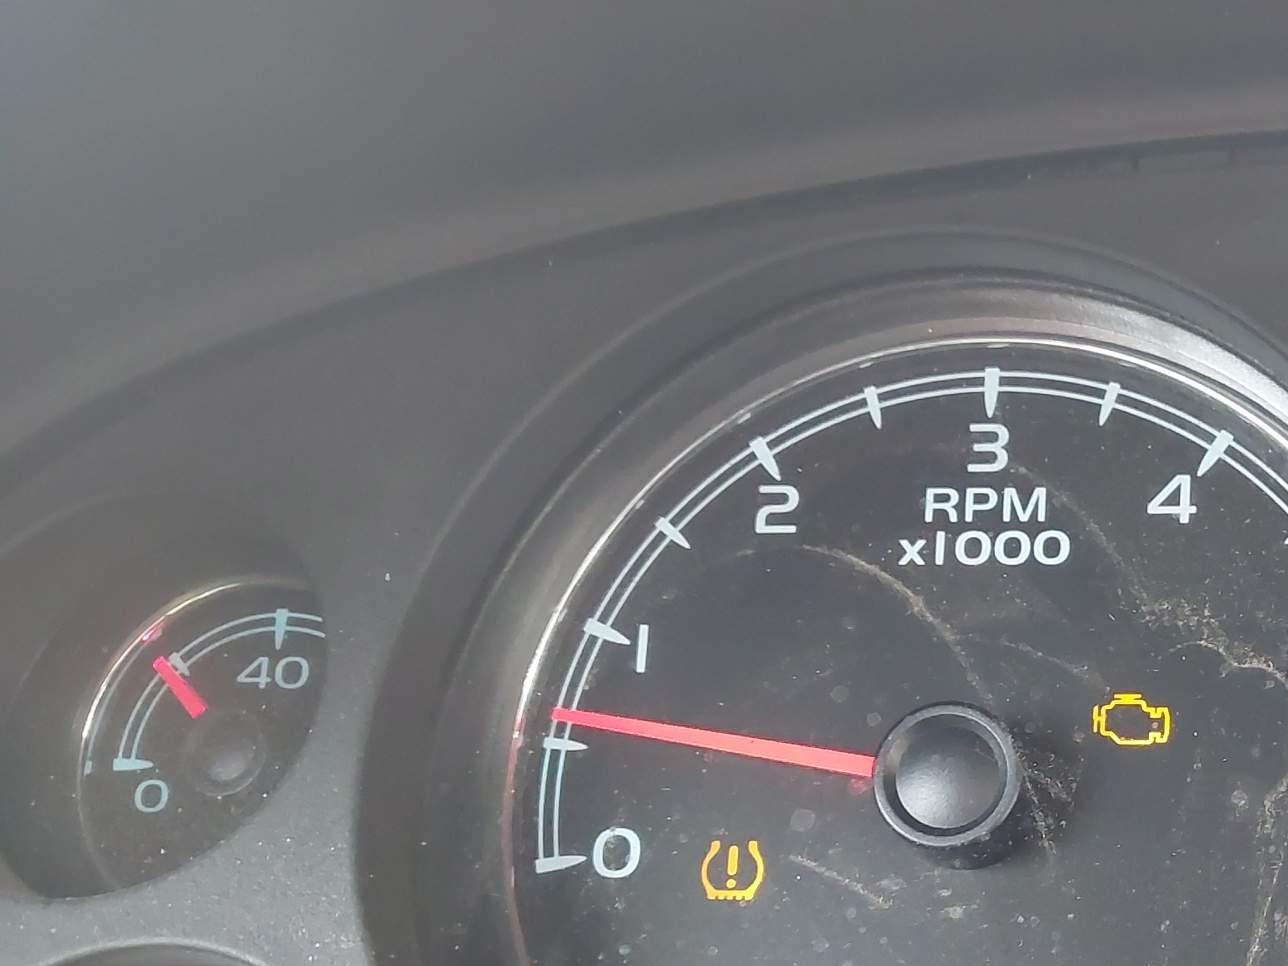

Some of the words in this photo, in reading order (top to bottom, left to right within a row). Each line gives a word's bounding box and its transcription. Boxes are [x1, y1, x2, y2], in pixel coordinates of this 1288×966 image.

[967, 424, 1009, 472] 3
[755, 485, 799, 533] 2
[924, 487, 1046, 522] RPM
[1147, 475, 1196, 523] 4
[898, 530, 1070, 565] x1000
[236, 657, 309, 688] 40
[635, 625, 649, 673] 1
[134, 780, 168, 812] 0
[593, 827, 641, 878] 0
